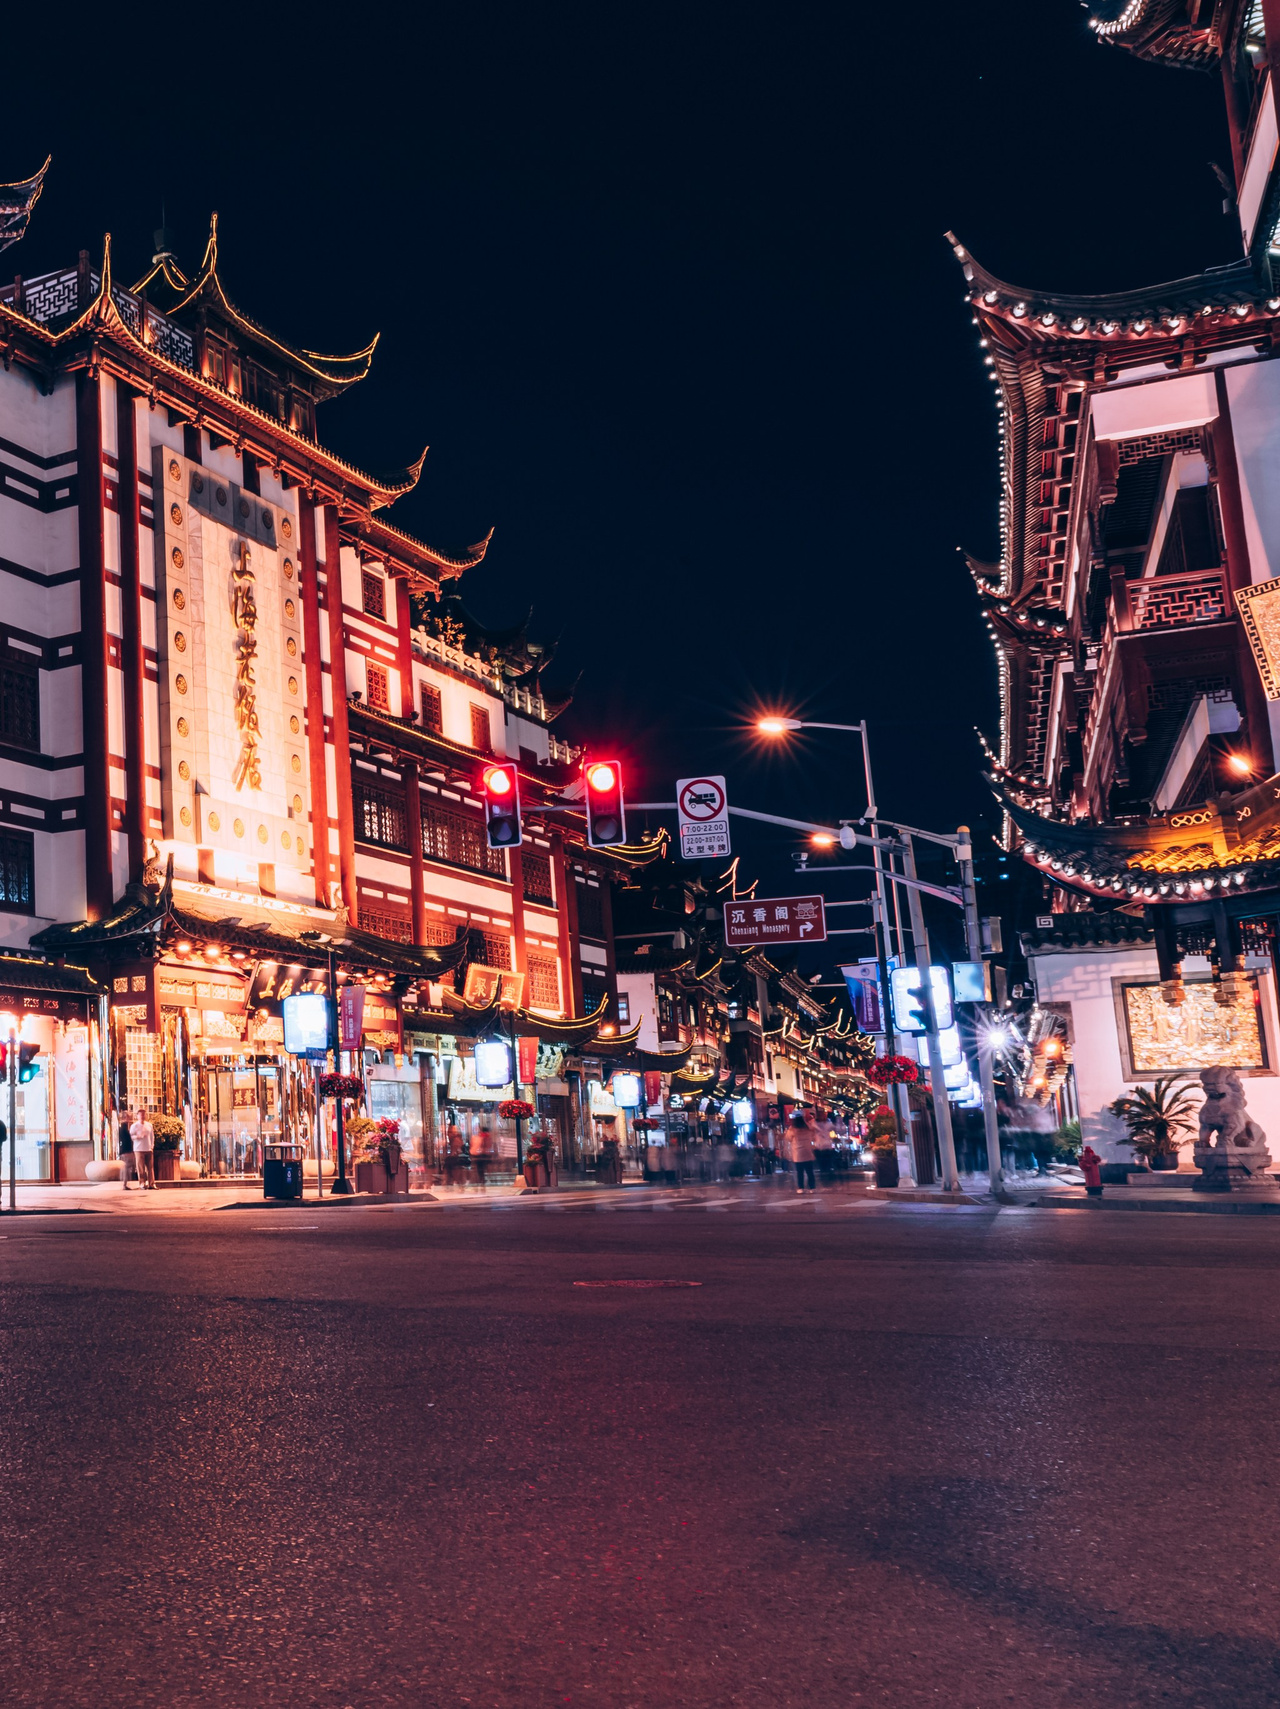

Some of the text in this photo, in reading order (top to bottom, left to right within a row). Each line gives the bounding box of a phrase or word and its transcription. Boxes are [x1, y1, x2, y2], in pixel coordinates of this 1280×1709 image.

[686, 844, 727, 855] 大型号牌
[731, 906, 789, 924] 沉香阁
[730, 925, 759, 937] Chenxiang
